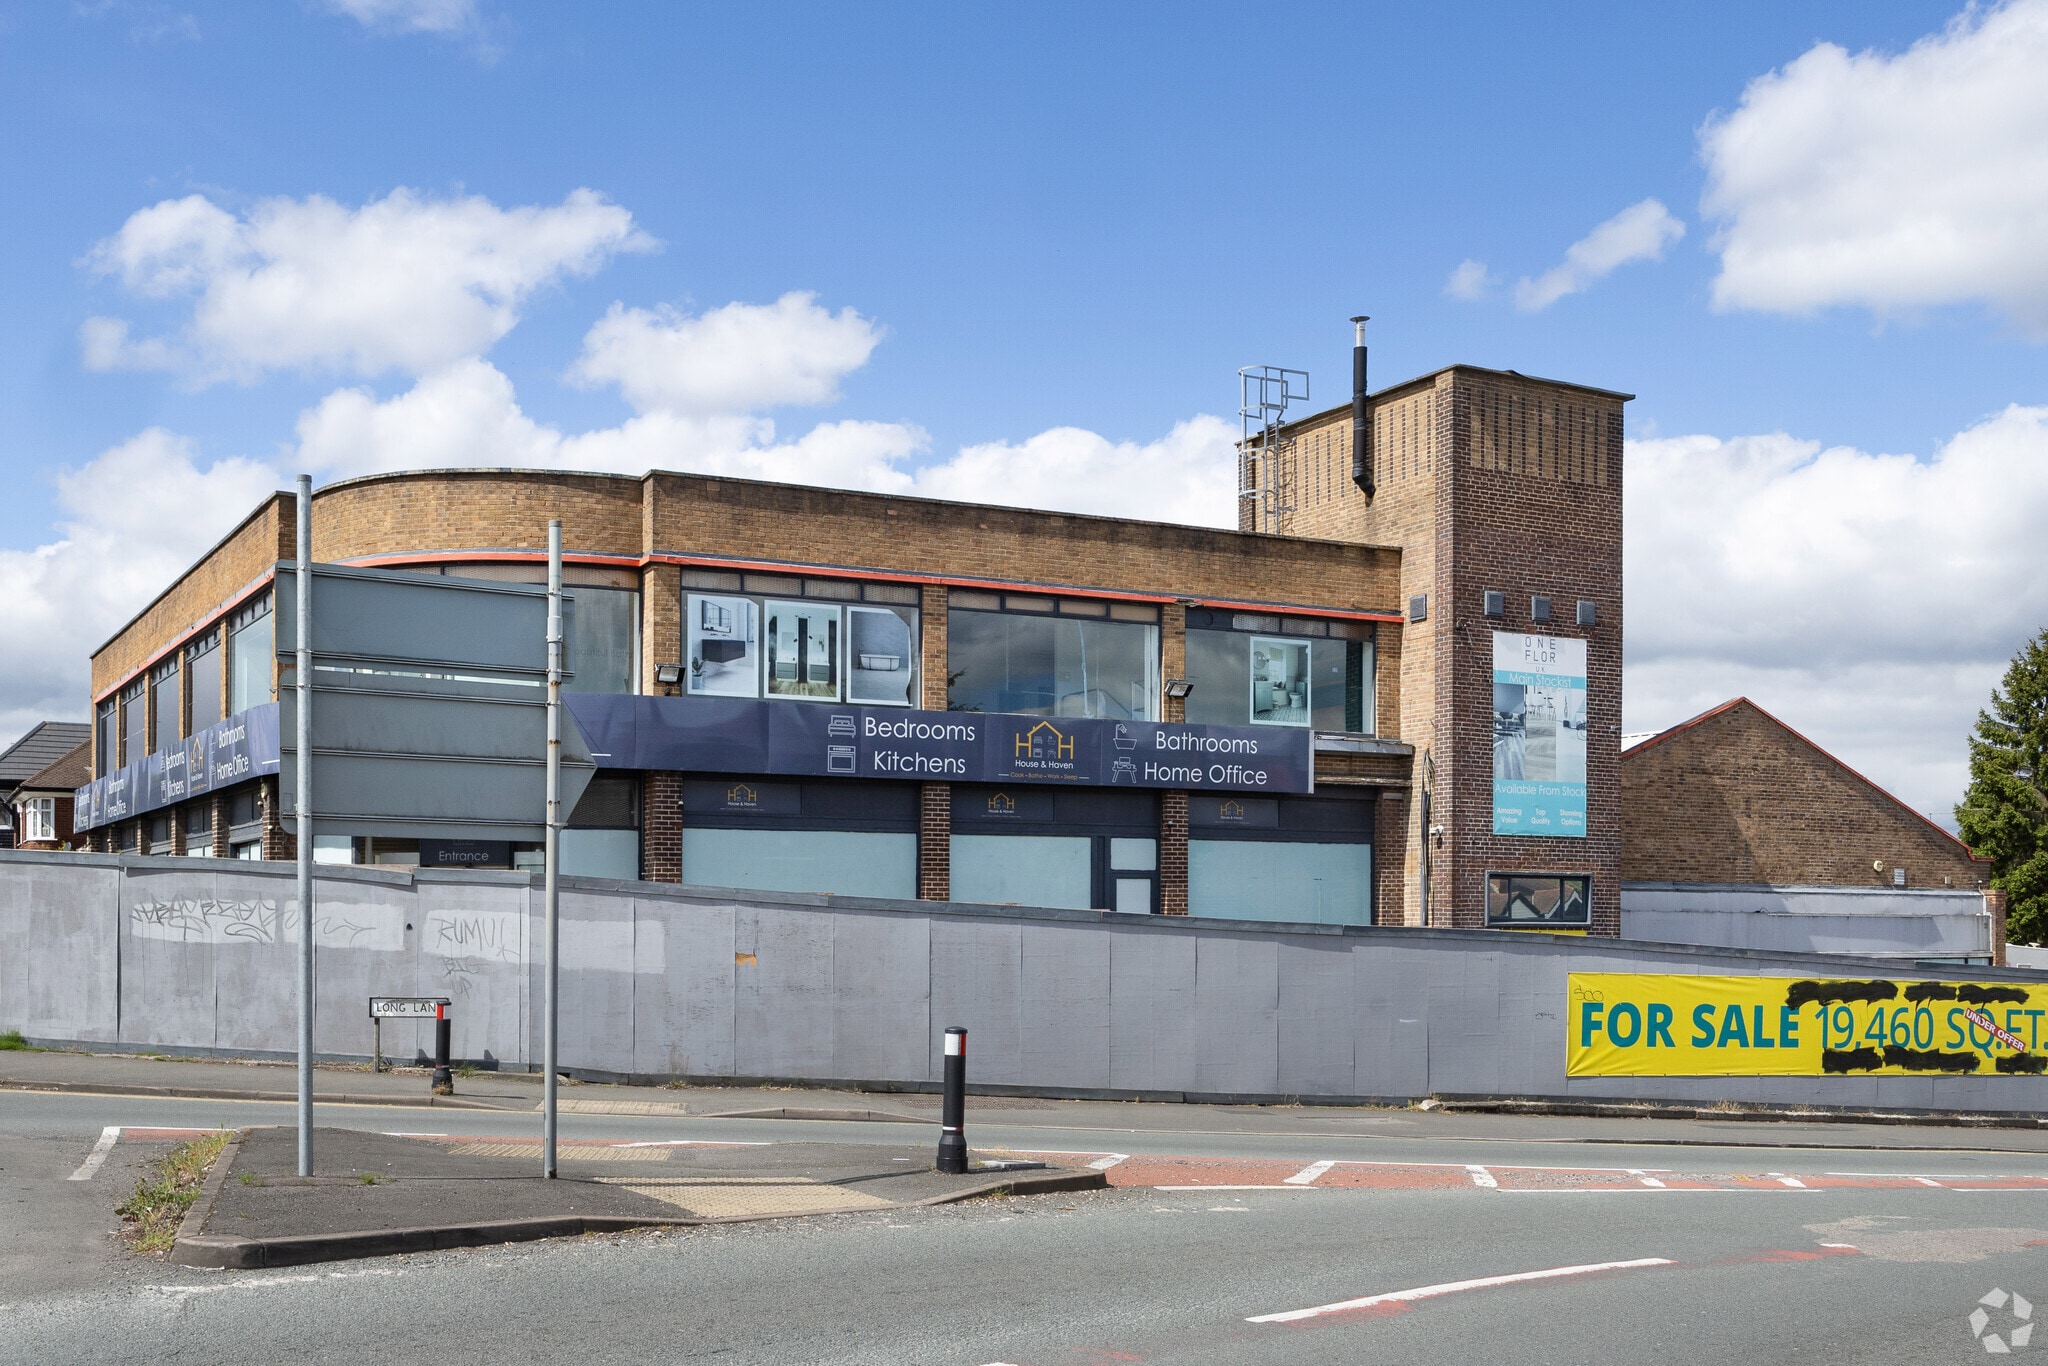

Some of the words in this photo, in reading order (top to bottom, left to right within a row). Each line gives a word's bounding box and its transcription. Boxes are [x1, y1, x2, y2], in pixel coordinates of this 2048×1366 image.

[1525, 636, 1556, 650] ONE
[1525, 650, 1556, 663] FLOR
[1509, 672, 1534, 684] Main
[1536, 674, 1572, 688] Stockist
[865, 716, 976, 742] Bedrooms
[1156, 731, 1258, 755] Bathrooms
[217, 760, 233, 781] Home
[233, 753, 249, 776] Office
[874, 751, 966, 774] Kitchens
[1015, 760, 1039, 768] House
[1048, 761, 1074, 769] Haven
[1144, 761, 1203, 783] Home
[1209, 764, 1268, 785] Office
[1495, 783, 1537, 795] Available
[1539, 785, 1560, 795] From
[1561, 786, 1585, 797] Stock
[1535, 808, 1546, 816] Top
[438, 850, 489, 861] Entrance
[376, 1002, 406, 1013] LONG
[413, 1002, 436, 1013] LAN
[1581, 1002, 1676, 1048] FOR
[1691, 1003, 1799, 1049] SALE
[1814, 1005, 1934, 1050] 19,460
[1965, 1009, 1997, 1035] UNDER
[1997, 1029, 2025, 1051] OFFER
